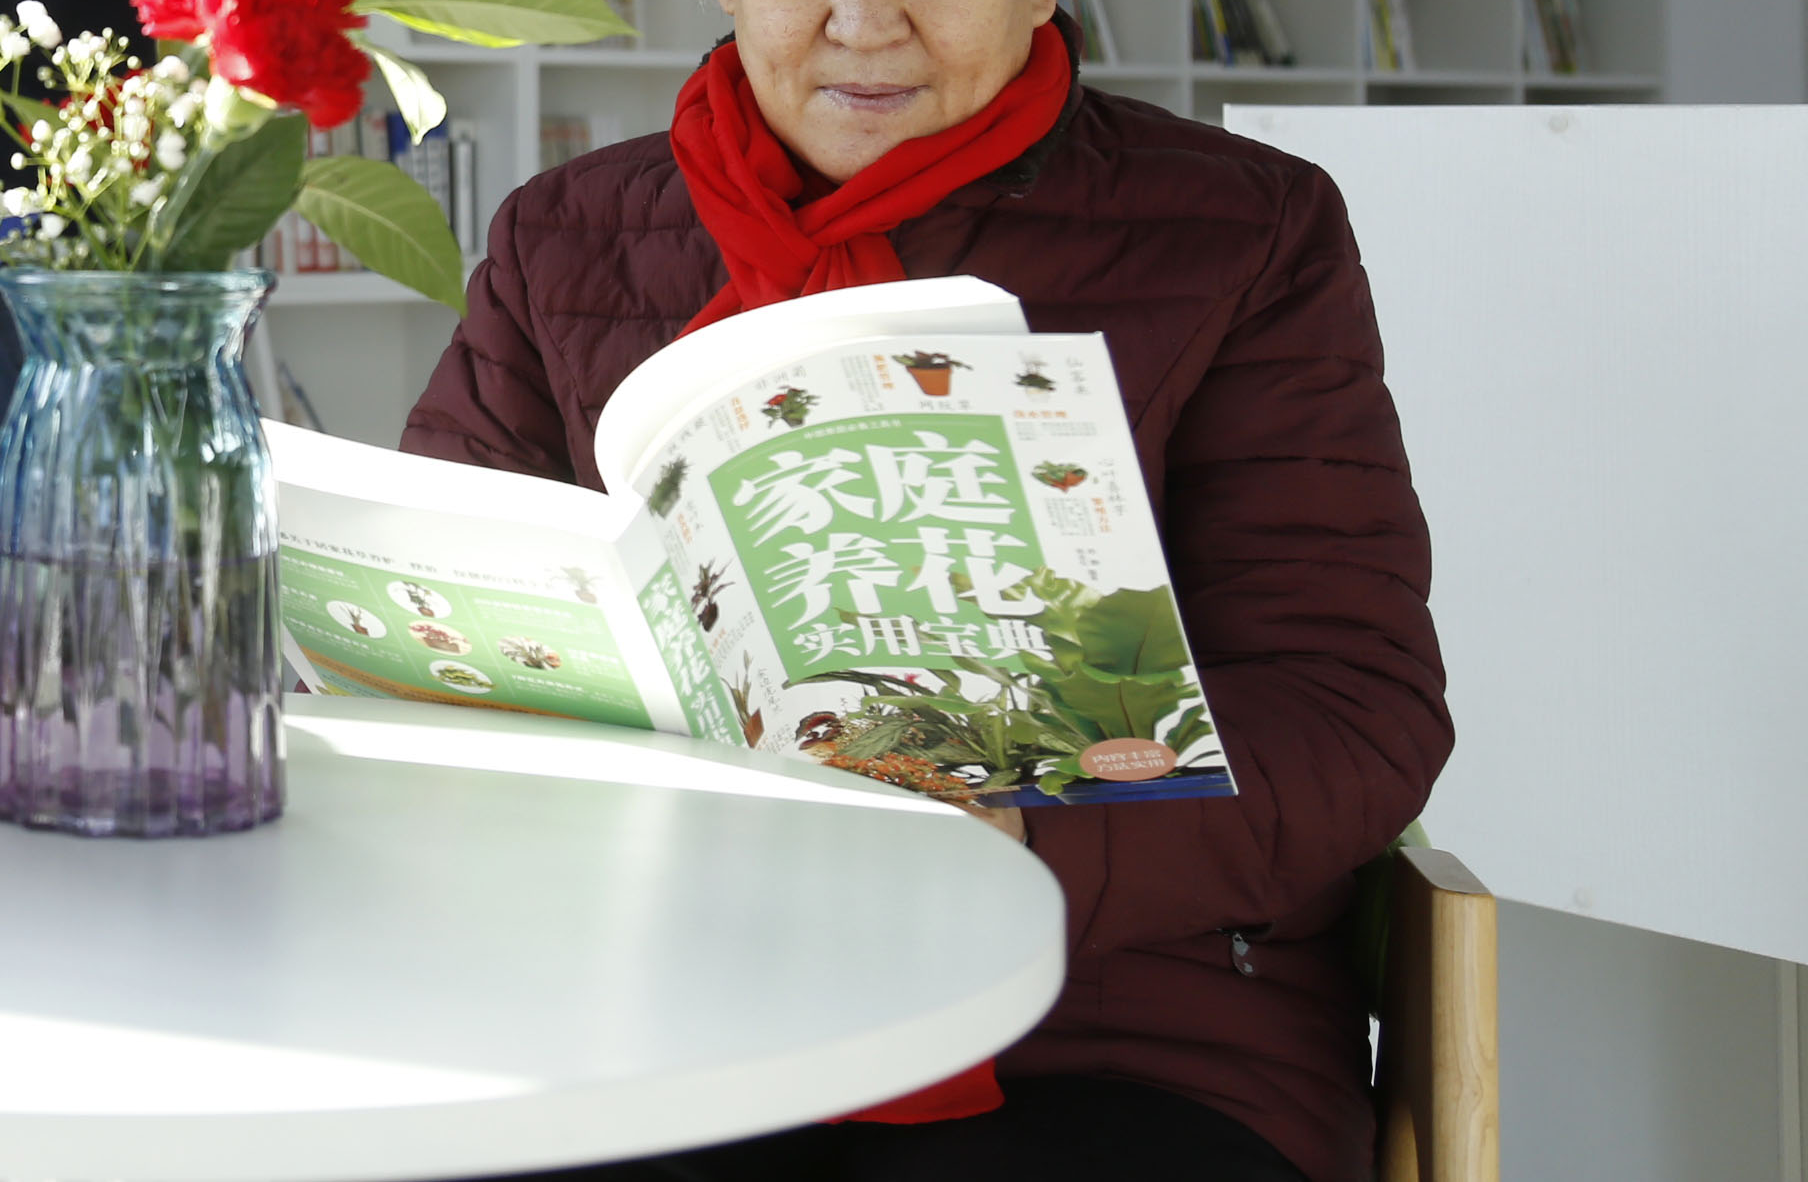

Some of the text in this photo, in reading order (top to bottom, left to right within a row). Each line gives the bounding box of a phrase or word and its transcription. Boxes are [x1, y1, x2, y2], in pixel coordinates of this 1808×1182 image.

[733, 431, 1016, 547] 家庭
[764, 526, 1049, 629] 养花
[793, 615, 1055, 666] 实用宝典
